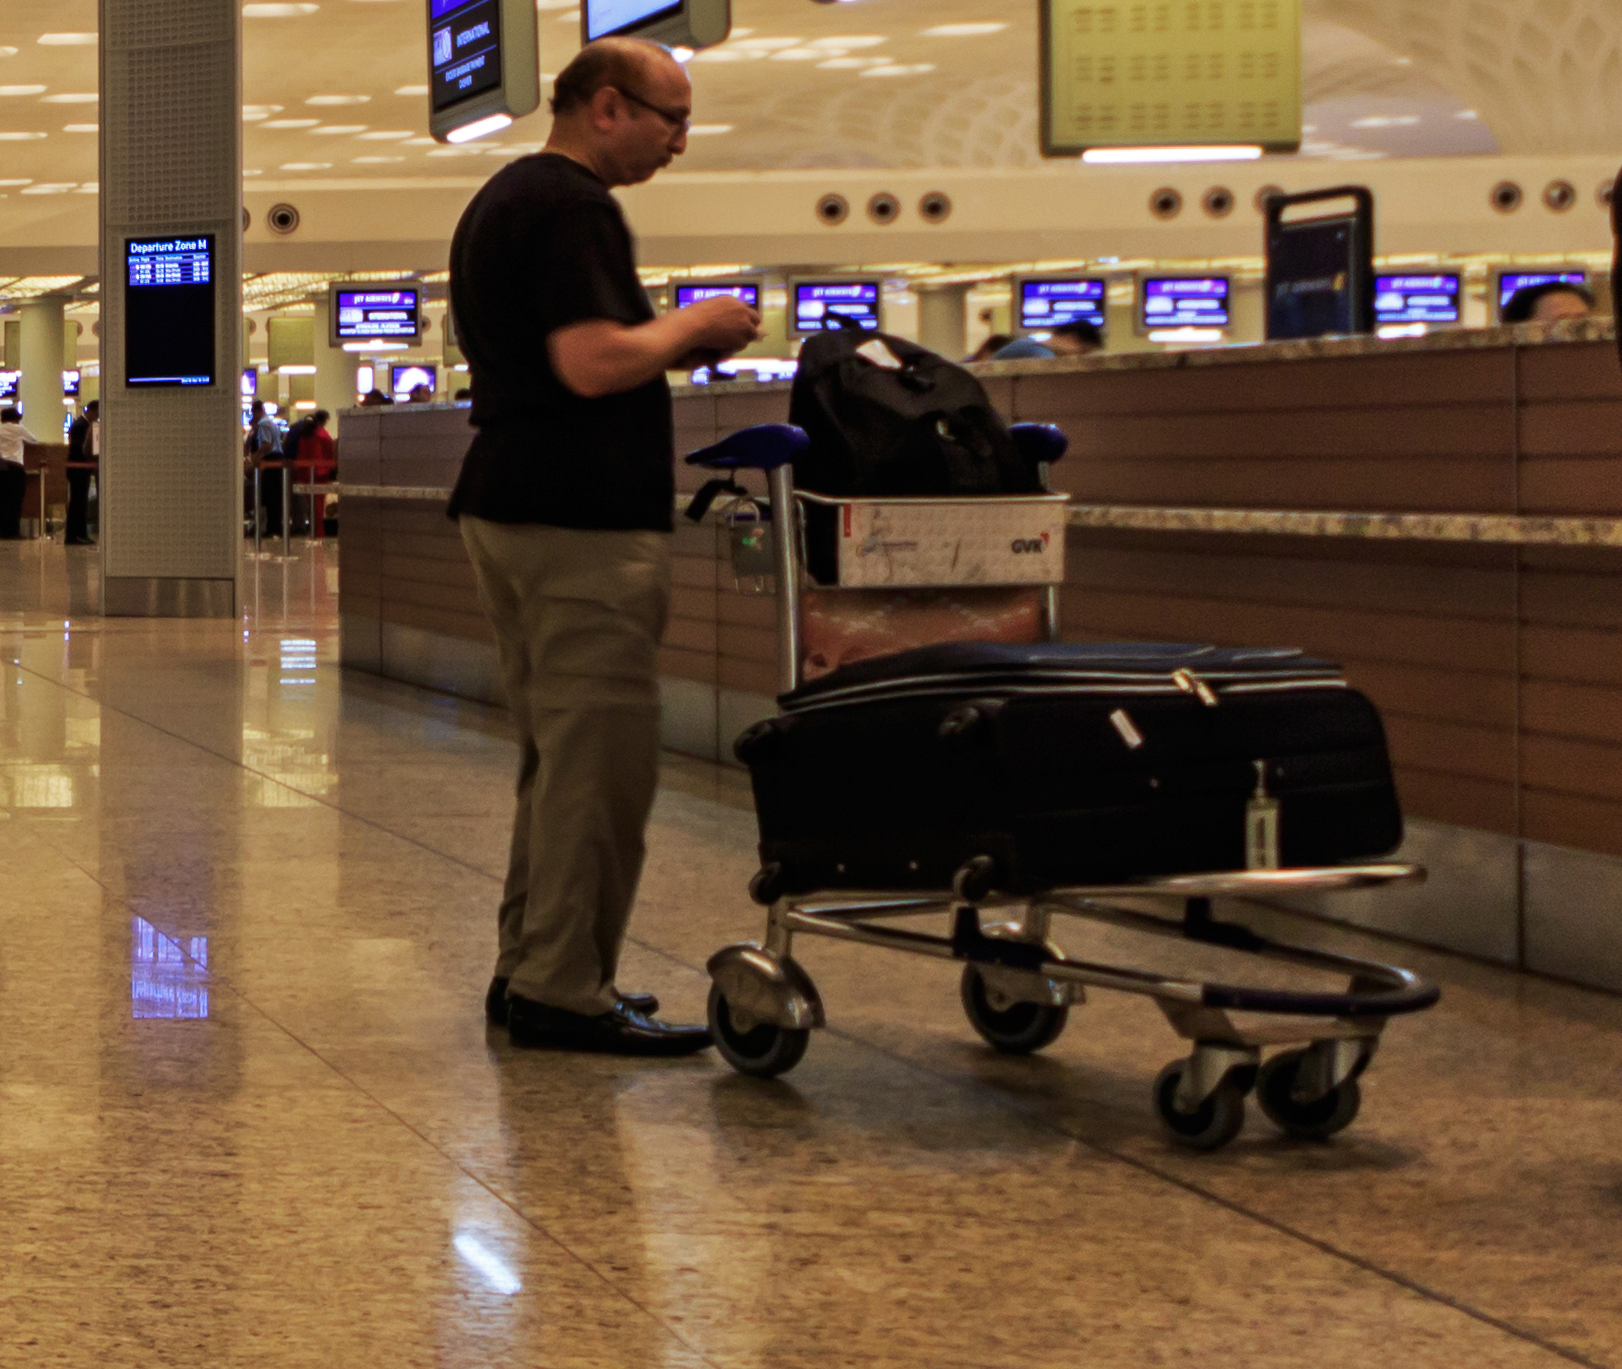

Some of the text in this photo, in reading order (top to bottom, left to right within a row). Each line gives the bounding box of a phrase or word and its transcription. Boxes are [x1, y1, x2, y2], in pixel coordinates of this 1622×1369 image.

[130, 237, 207, 254] Departure Zone M
[1011, 538, 1043, 554] GVK
